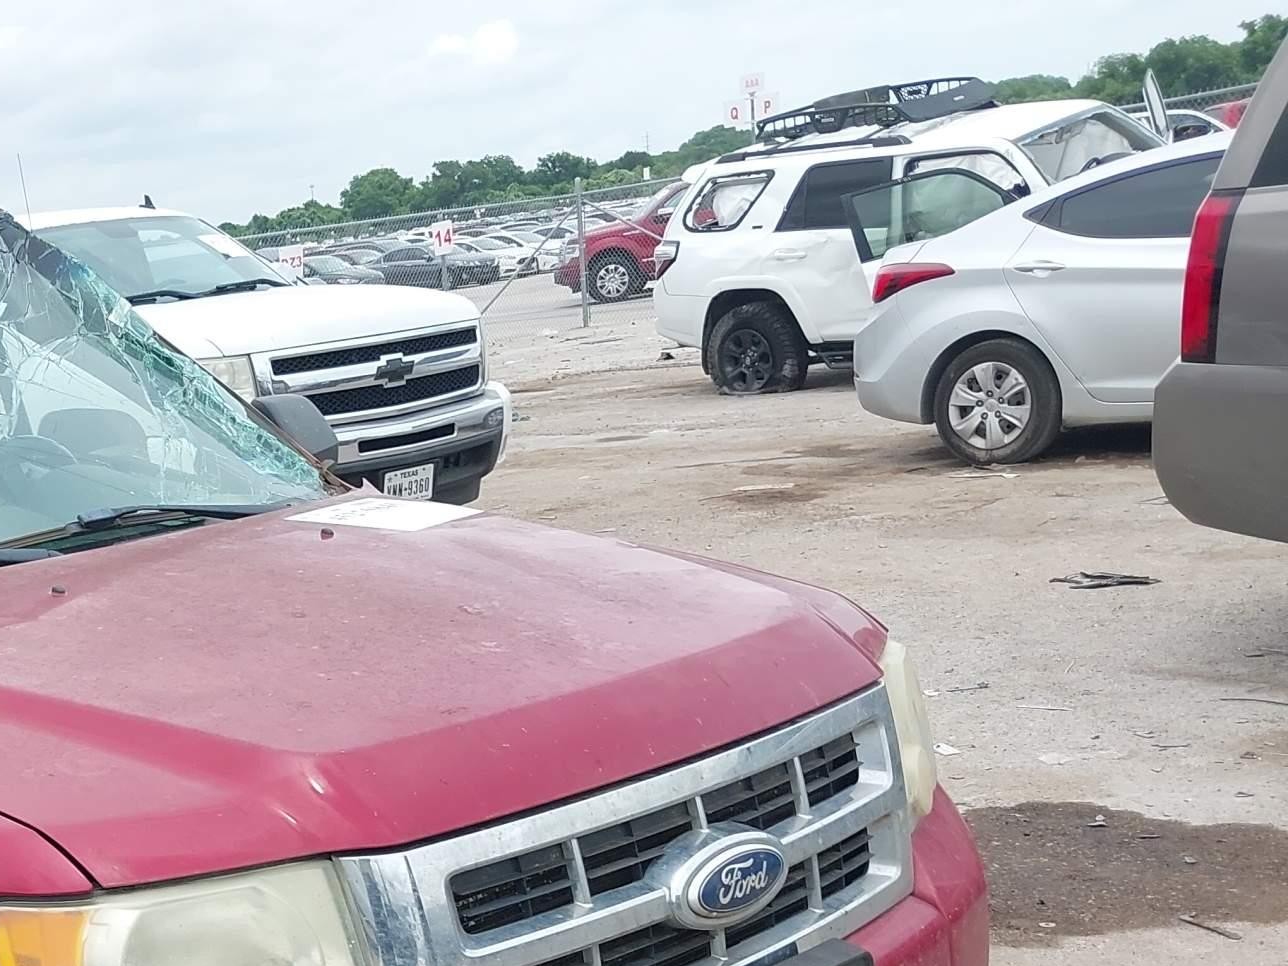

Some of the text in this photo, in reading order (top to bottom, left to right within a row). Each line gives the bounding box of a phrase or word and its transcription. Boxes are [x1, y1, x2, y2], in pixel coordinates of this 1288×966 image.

[730, 107, 738, 120] Q
[764, 100, 771, 114] P
[434, 228, 452, 247] 14
[400, 469, 418, 479] TEXAS
[719, 858, 768, 904] Ford
